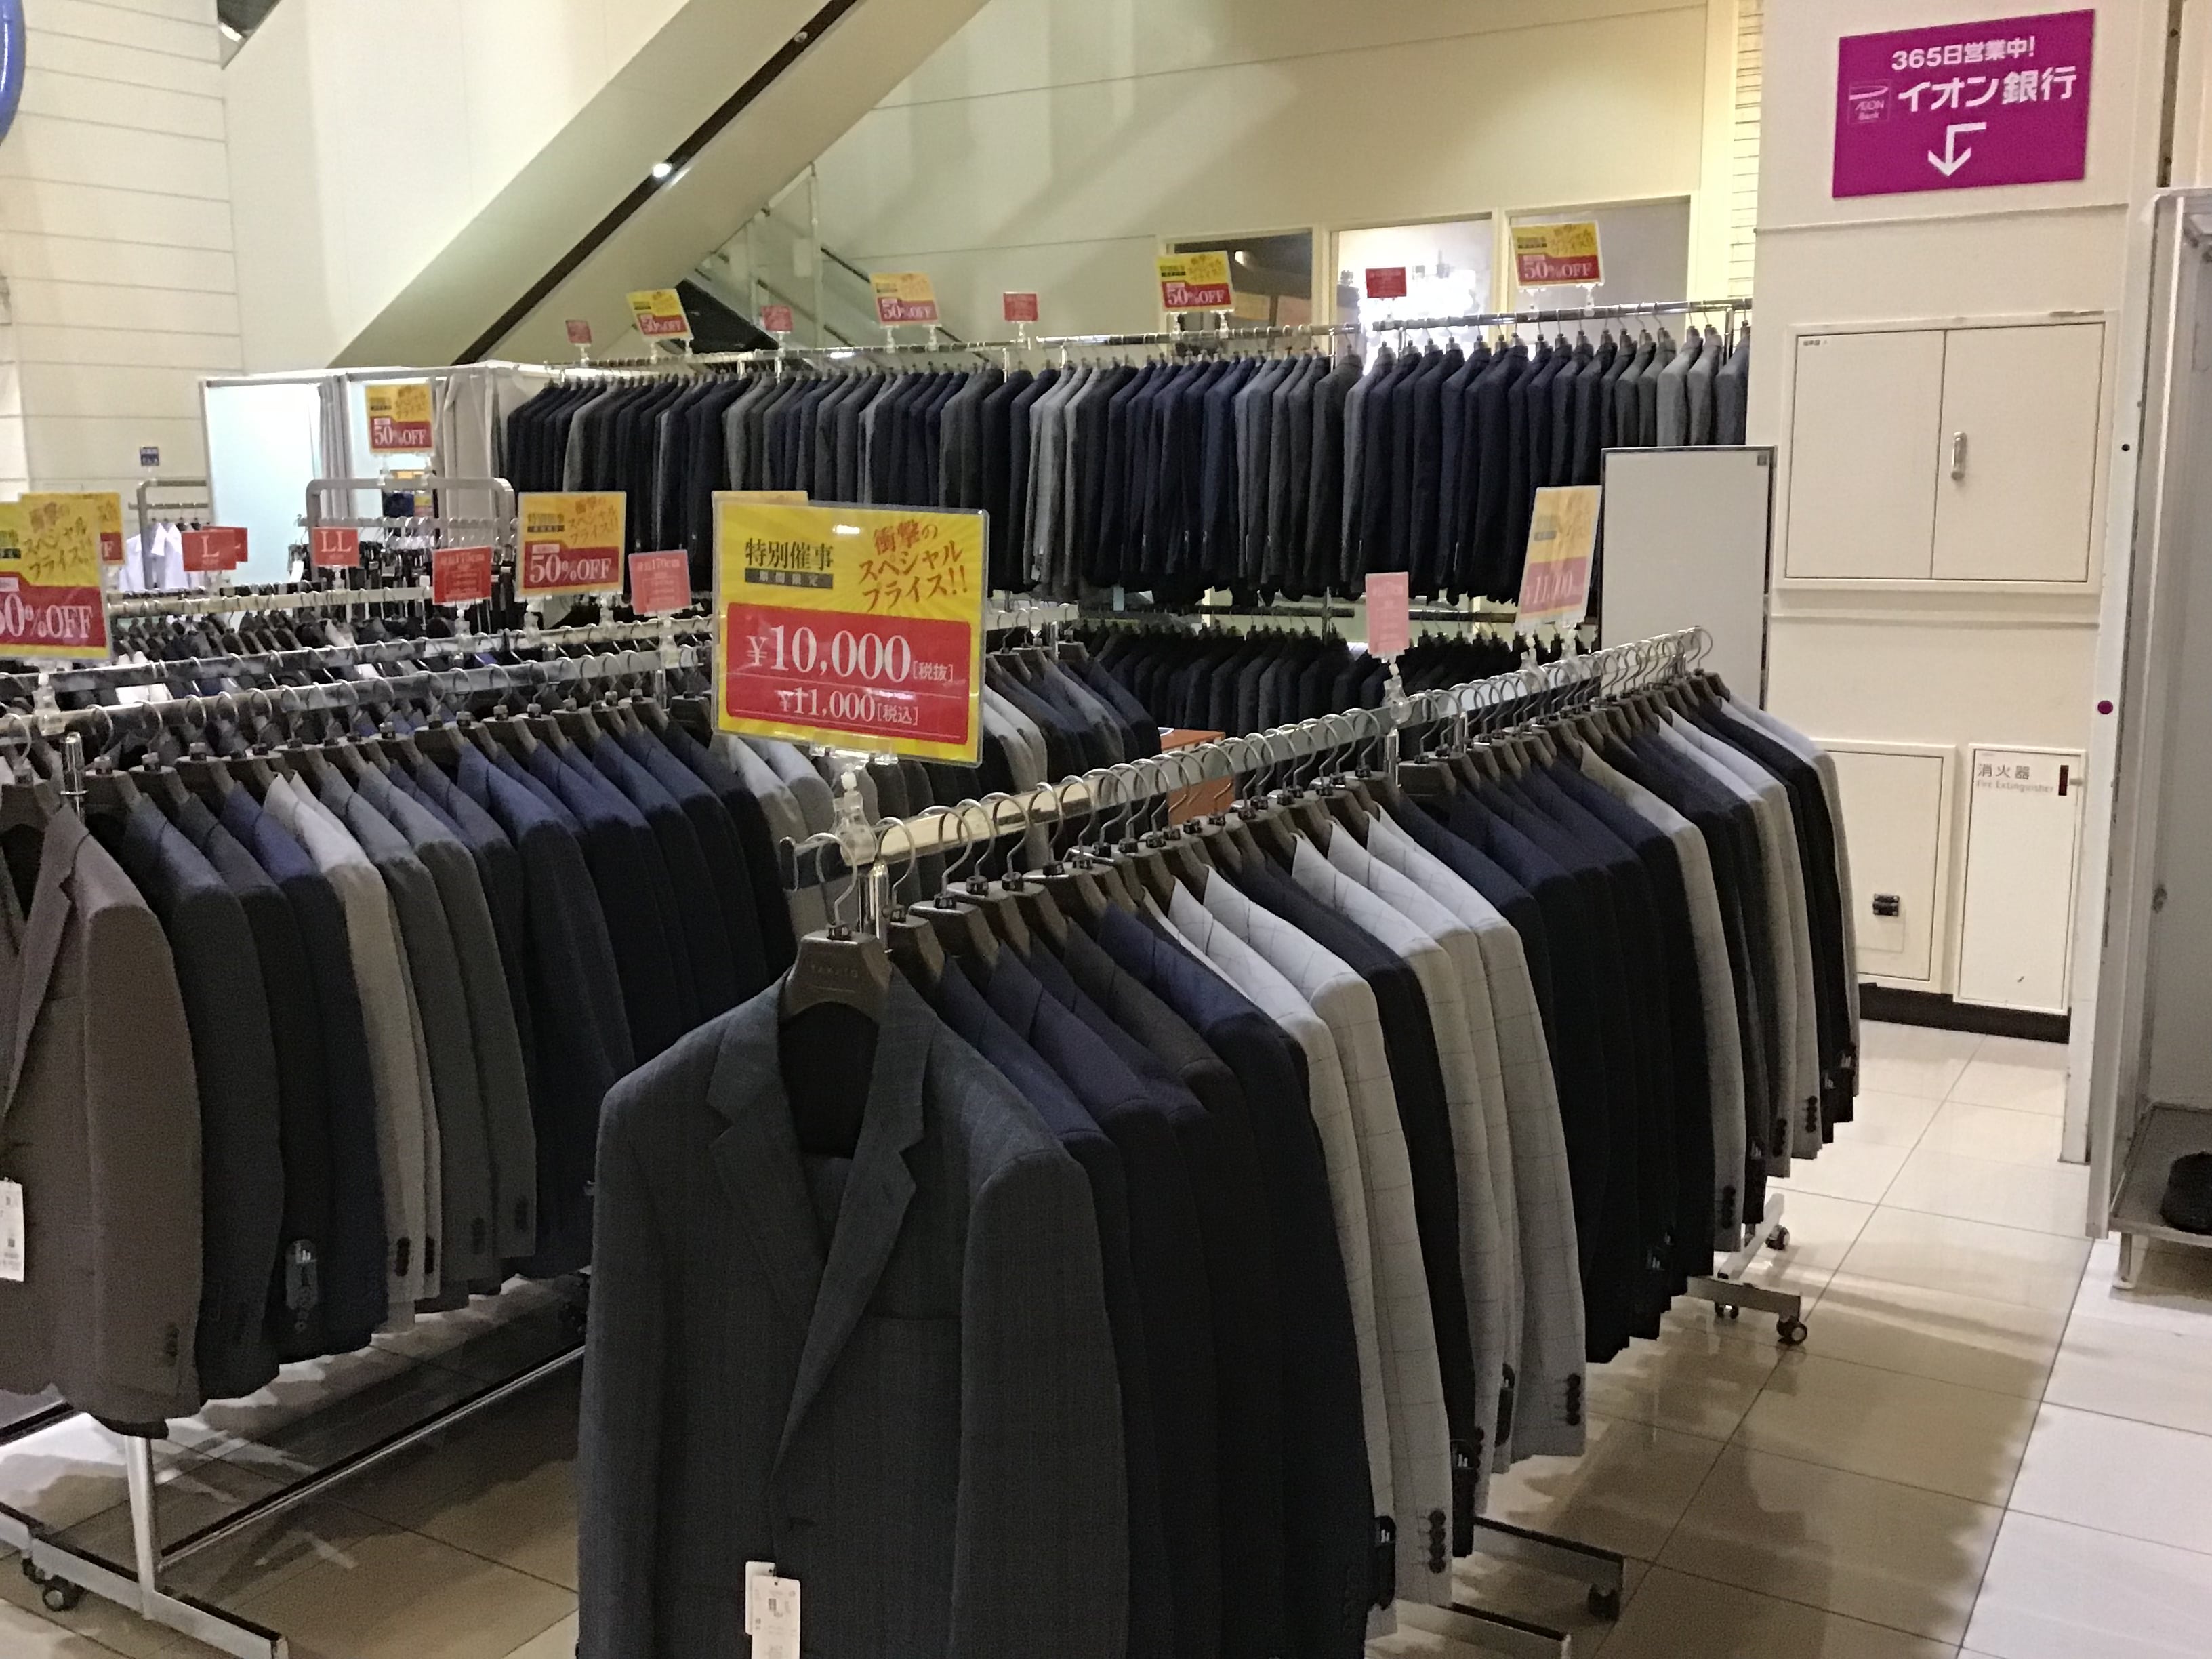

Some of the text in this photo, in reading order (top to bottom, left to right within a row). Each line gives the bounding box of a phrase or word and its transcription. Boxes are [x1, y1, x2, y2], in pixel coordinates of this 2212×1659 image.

[1891, 35, 2036, 70] 365日営業中!
[1898, 65, 2078, 112] イオン銀行
[201, 535, 220, 558] L
[321, 530, 352, 552] LL
[745, 537, 834, 571] 特別催事
[529, 554, 612, 583] 50%OFF
[859, 539, 964, 585] スペシャル
[747, 624, 912, 683] ¥10,000
[1978, 763, 2030, 780] 消火器
